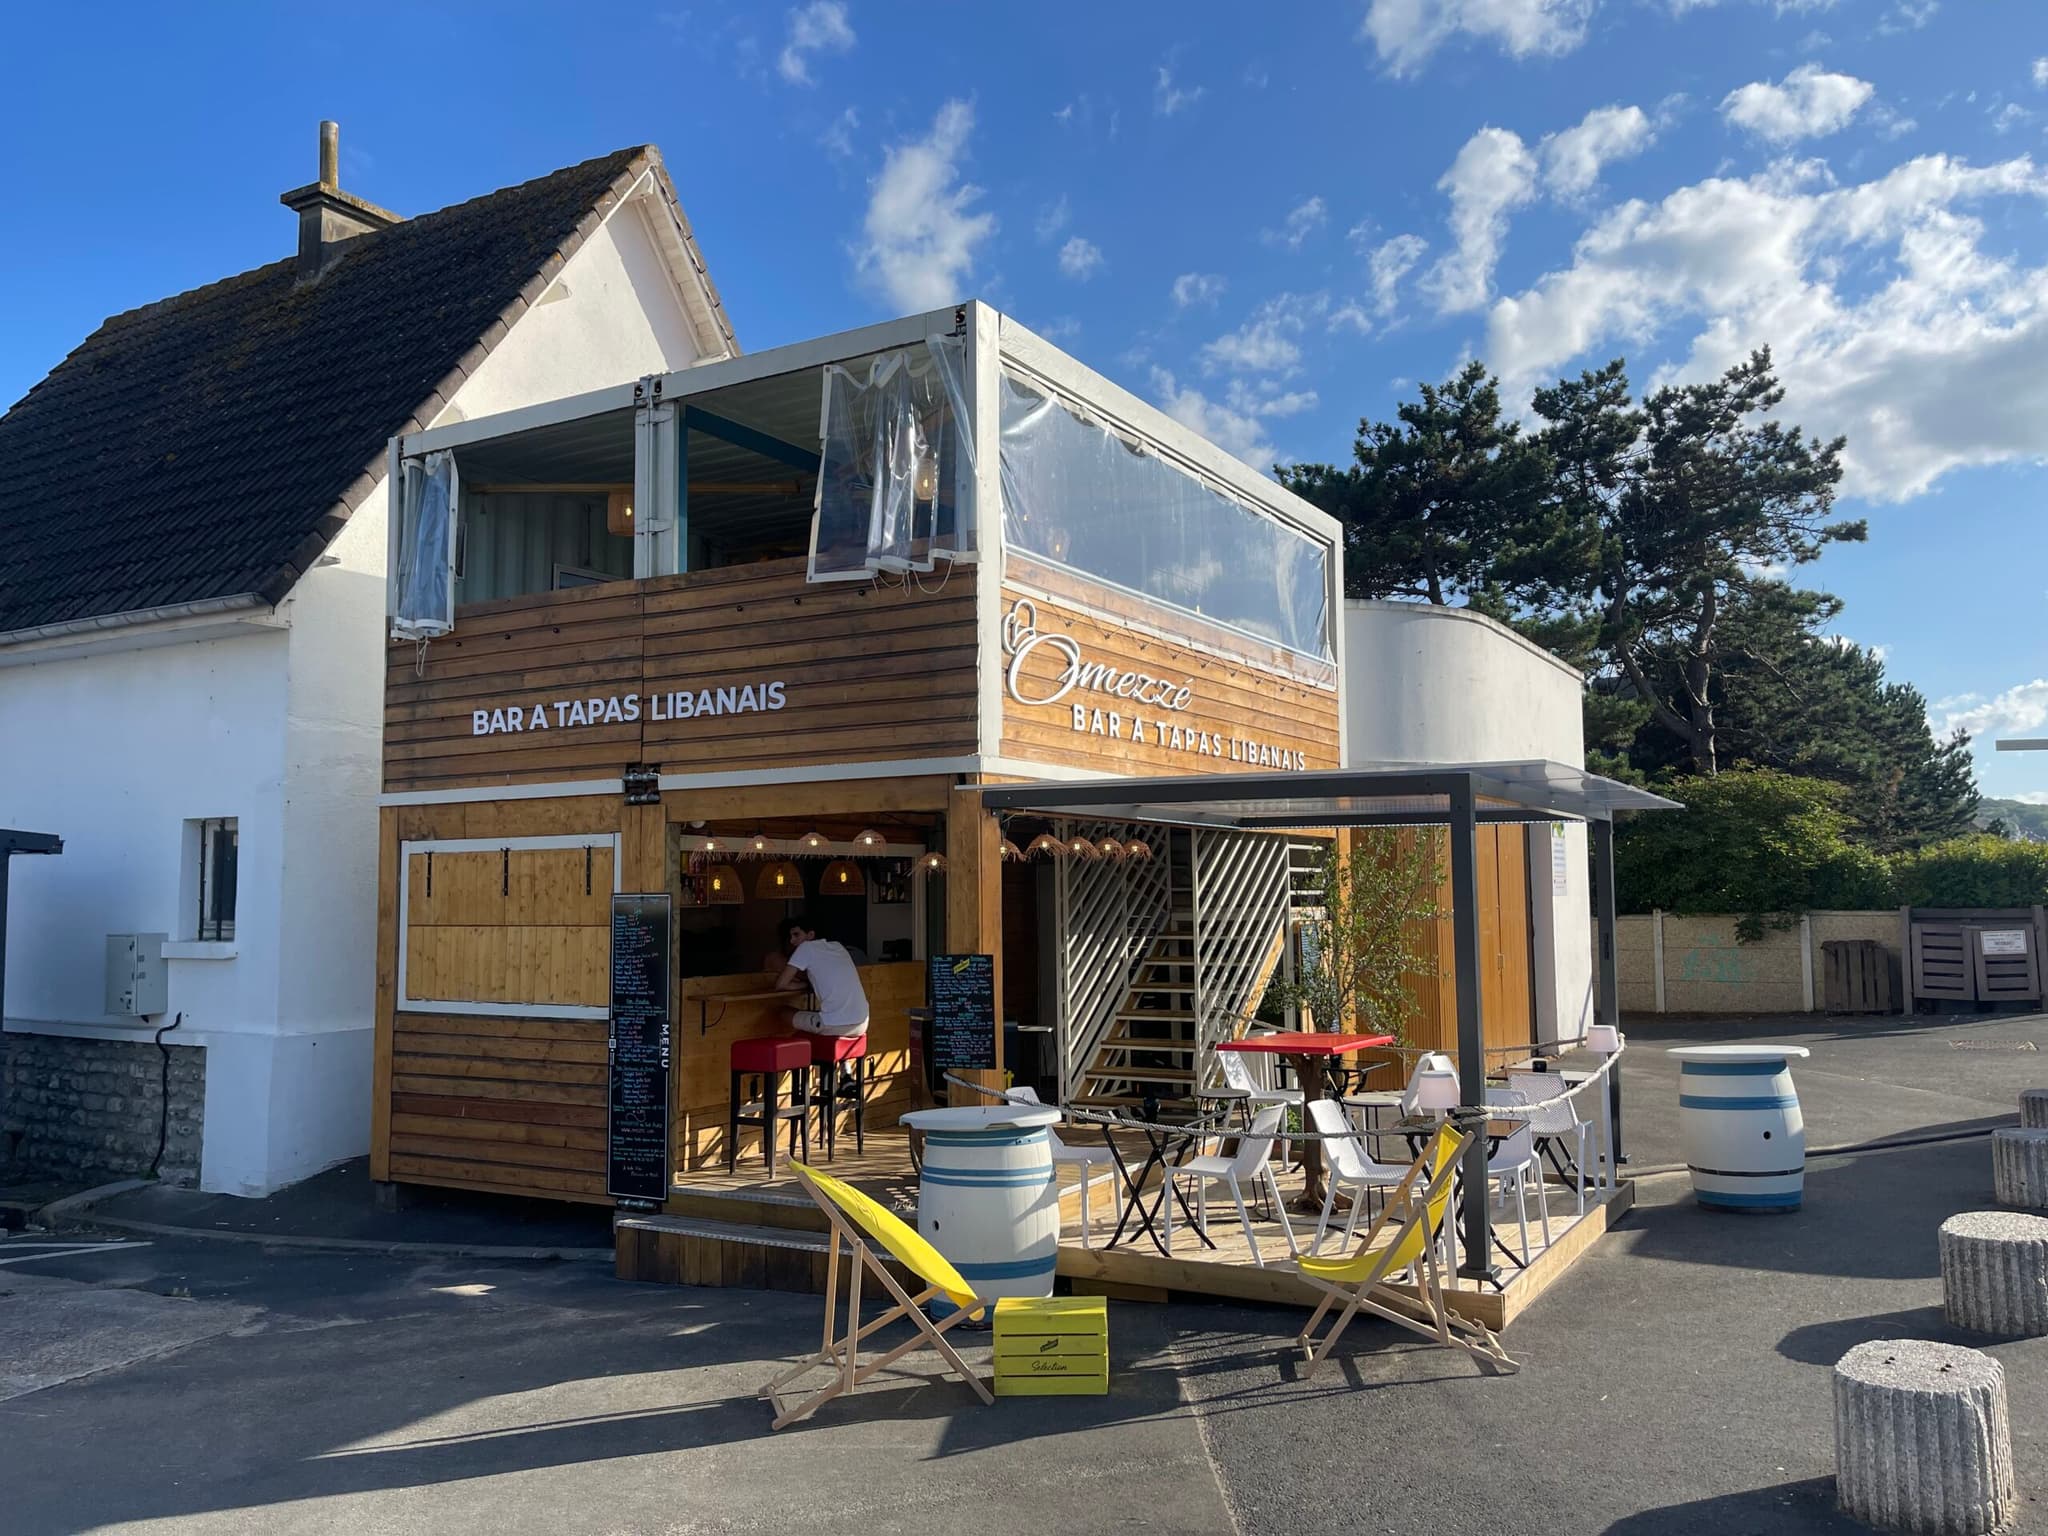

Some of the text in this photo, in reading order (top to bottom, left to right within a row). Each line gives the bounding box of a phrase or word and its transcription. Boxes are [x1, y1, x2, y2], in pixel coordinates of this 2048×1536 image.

[472, 681, 786, 736] BAR A TAPAS LIBANAIS
[1072, 704, 1305, 771] BAR A TAPAS LIBANAIS
[661, 1024, 669, 1068] MENU
